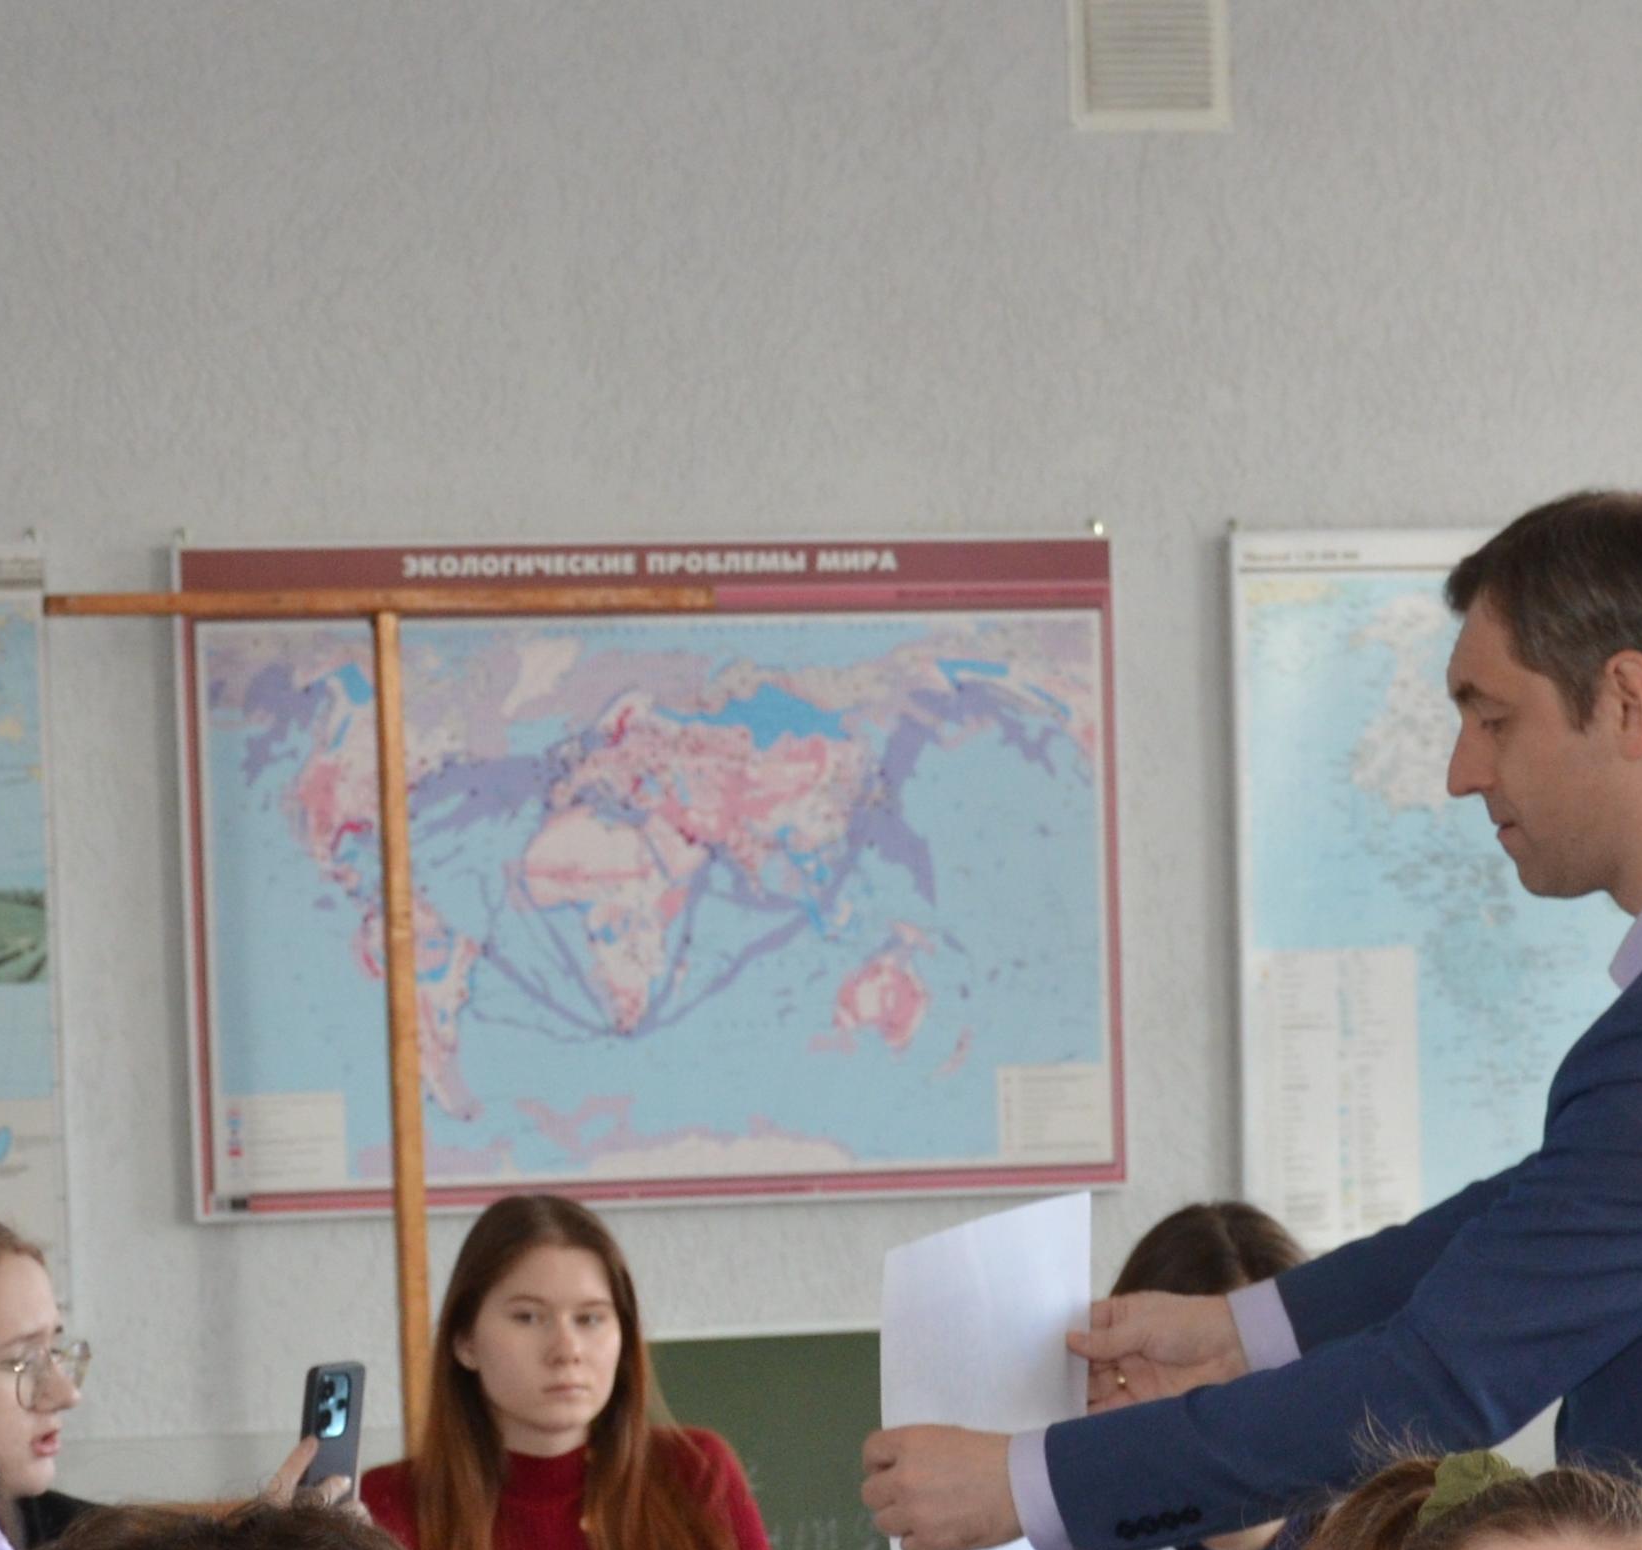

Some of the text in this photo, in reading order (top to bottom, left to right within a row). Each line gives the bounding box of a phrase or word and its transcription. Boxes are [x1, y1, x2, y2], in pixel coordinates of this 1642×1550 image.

[402, 550, 899, 578] ЭКОЛОГИЧЕСКИЕ ПРОБЛЕМЫ МИРА
